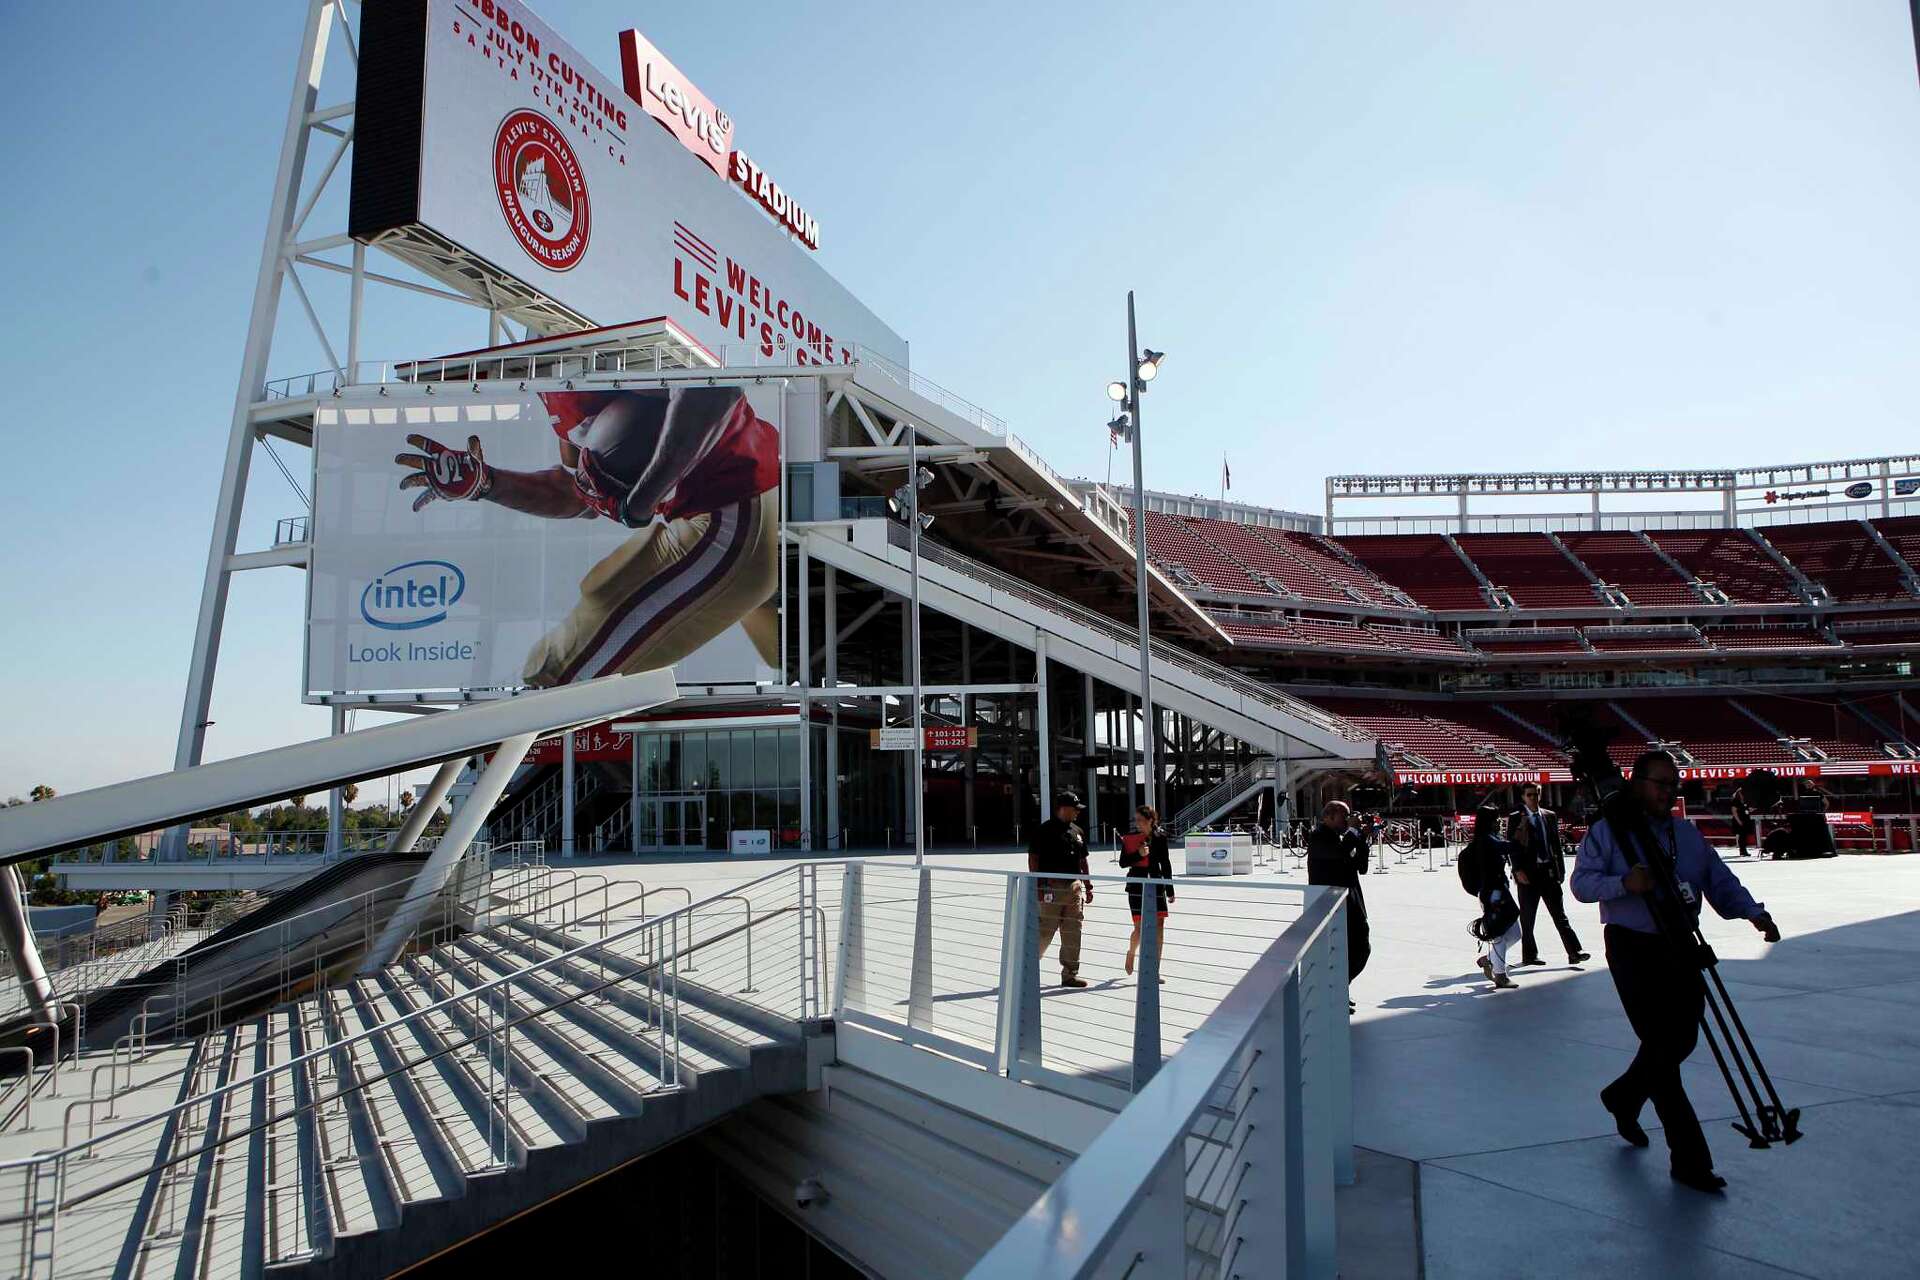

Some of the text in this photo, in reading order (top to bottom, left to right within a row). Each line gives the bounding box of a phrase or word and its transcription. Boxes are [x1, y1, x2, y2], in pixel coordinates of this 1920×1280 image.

[453, 21, 518, 80] SANTA
[609, 145, 626, 165] CA
[468, 0, 627, 131] BBON CUTTING
[487, 28, 603, 130] JULY 17TH, 2014
[543, 127, 581, 192] STADIUM
[503, 189, 581, 260] INAUGURAL SEASON
[733, 150, 820, 249] STADIUM
[726, 257, 833, 363] WELCOME
[375, 575, 447, 609] intel
[349, 640, 402, 662] Look
[1400, 773, 1447, 783] WELCOME
[1450, 773, 1462, 783] TO
[1501, 772, 1541, 782] STADIUM
[1679, 769, 1687, 779] O
[1745, 766, 1806, 778] SDIUM
[1891, 764, 1920, 774] WEL
